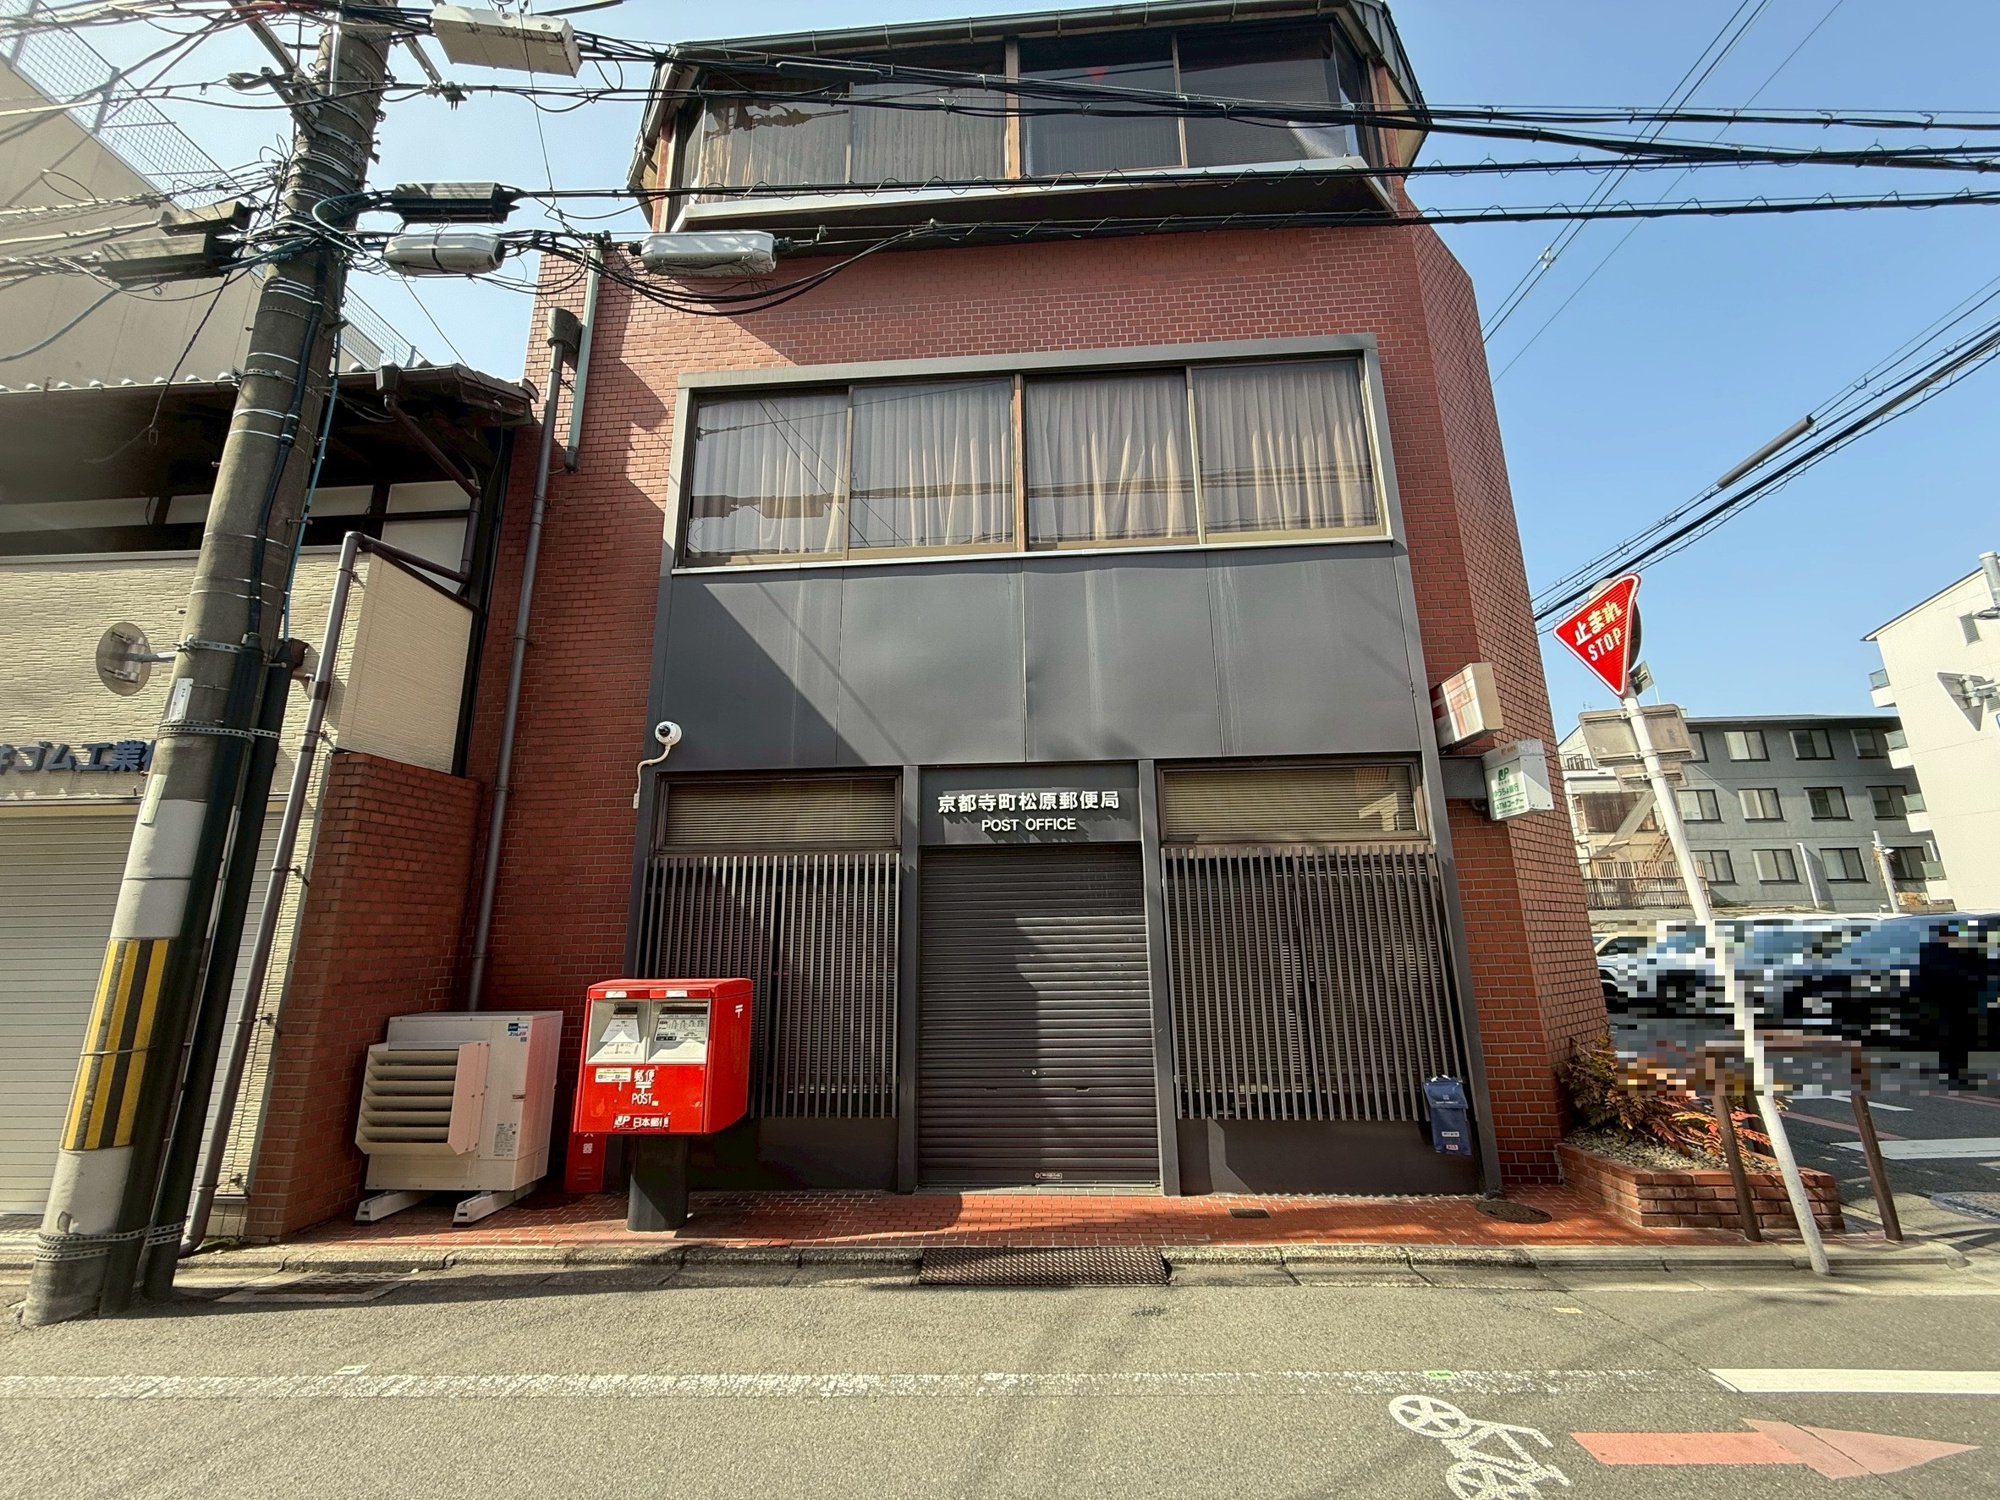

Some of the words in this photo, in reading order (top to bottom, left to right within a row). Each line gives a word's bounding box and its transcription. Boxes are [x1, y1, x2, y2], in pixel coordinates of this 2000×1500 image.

[1574, 601, 1623, 646] 止まれ
[1587, 627, 1622, 662] STOP
[937, 790, 1120, 814] 京都寺町松原郵便局
[981, 819, 1020, 832] POST
[1025, 817, 1077, 831] OFFICE
[634, 1069, 655, 1082] 郵便
[631, 1092, 653, 1105] POST
